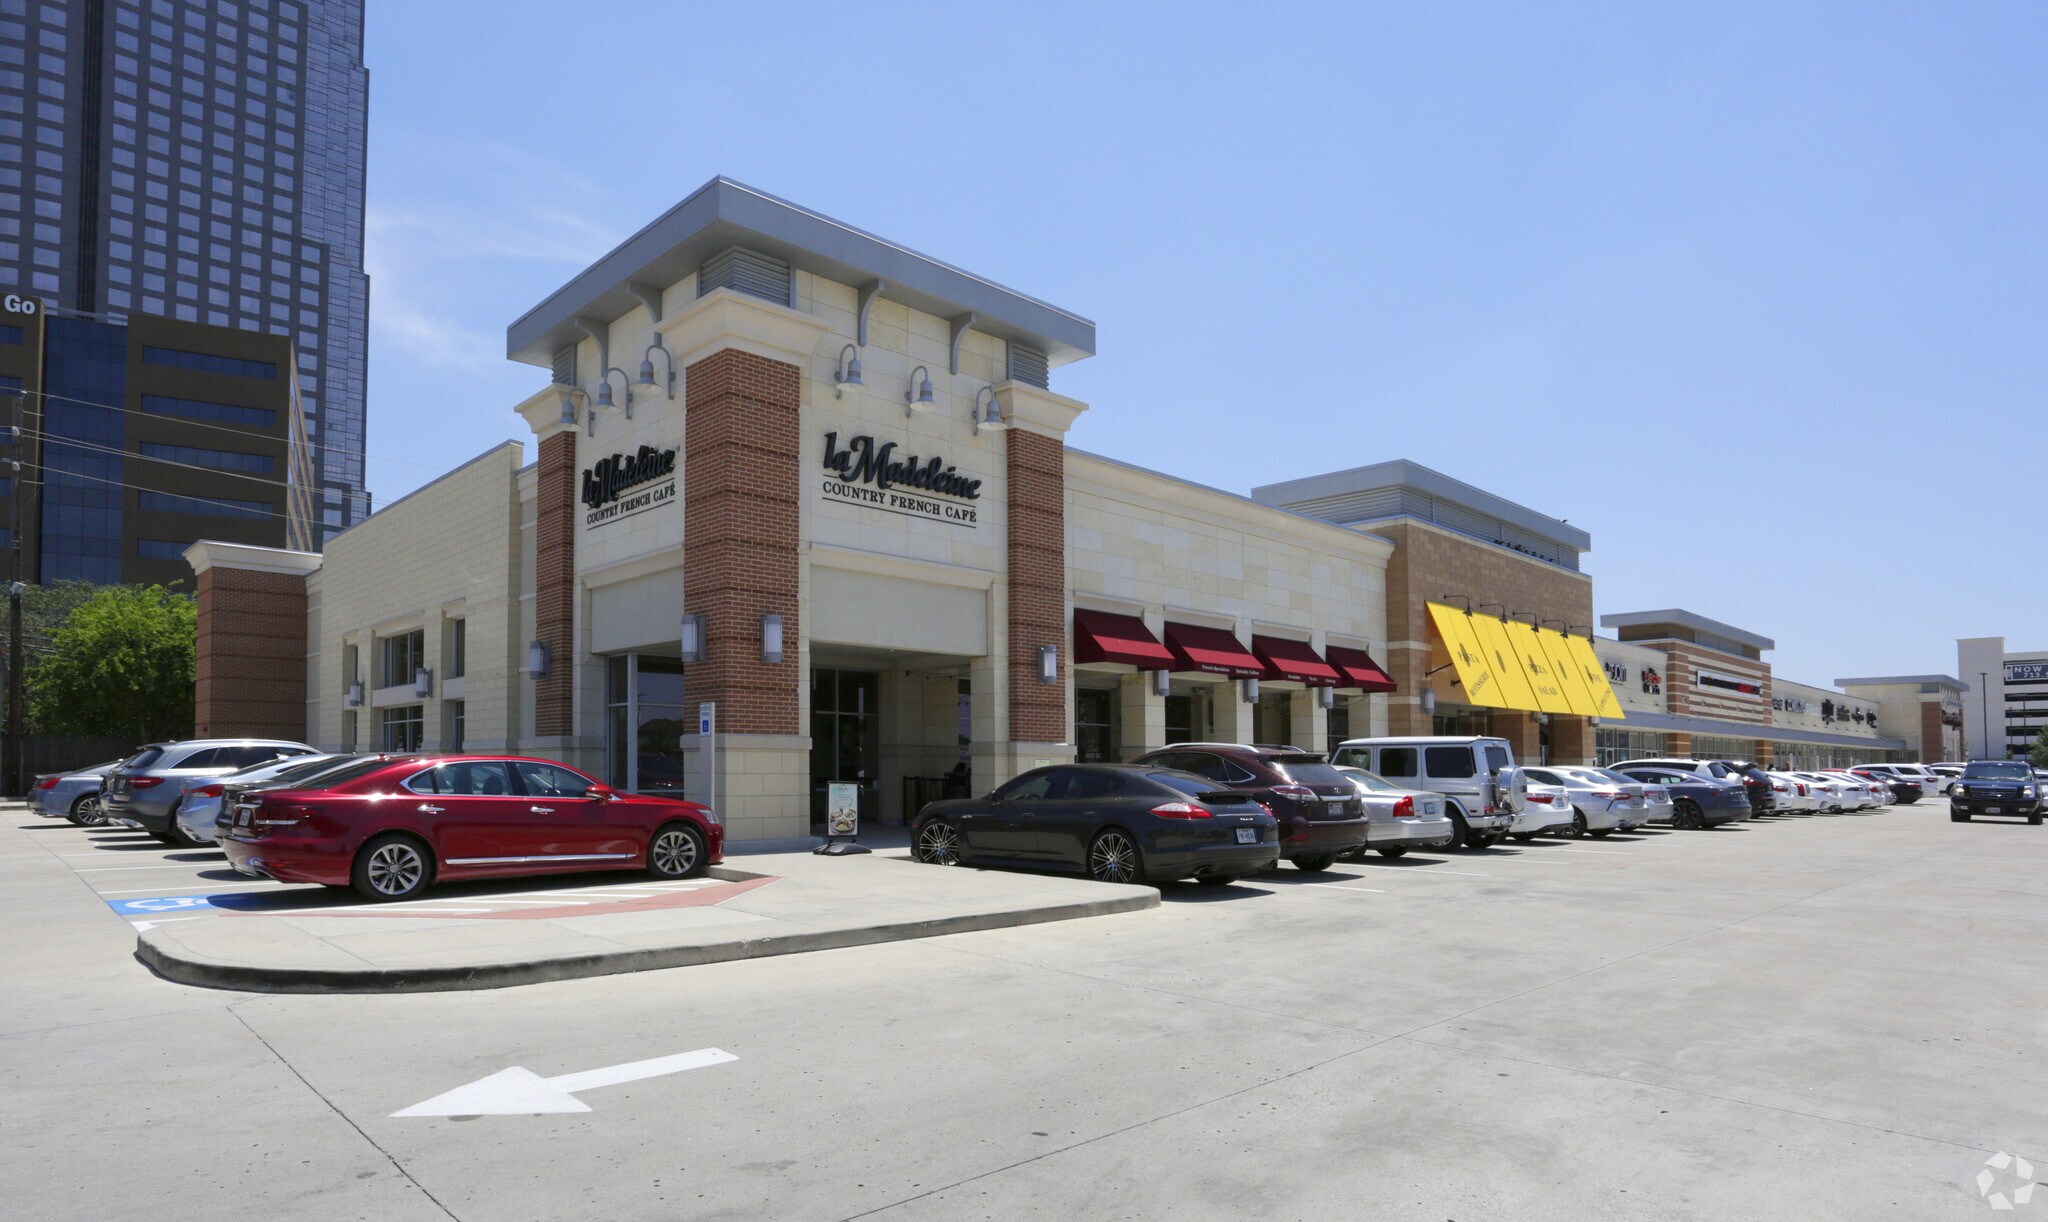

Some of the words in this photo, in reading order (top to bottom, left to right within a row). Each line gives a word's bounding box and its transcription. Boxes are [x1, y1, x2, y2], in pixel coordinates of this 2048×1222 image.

[4, 294, 36, 315] Go
[823, 431, 853, 472] la
[586, 503, 619, 525] COUNTRY
[620, 492, 651, 514] FRENCH
[653, 481, 676, 502] CAFÉ
[822, 481, 886, 505] COUNTRY
[890, 494, 941, 516] FRENCH
[945, 506, 977, 523] CAFÉ
[2014, 665, 2042, 673] NOW
